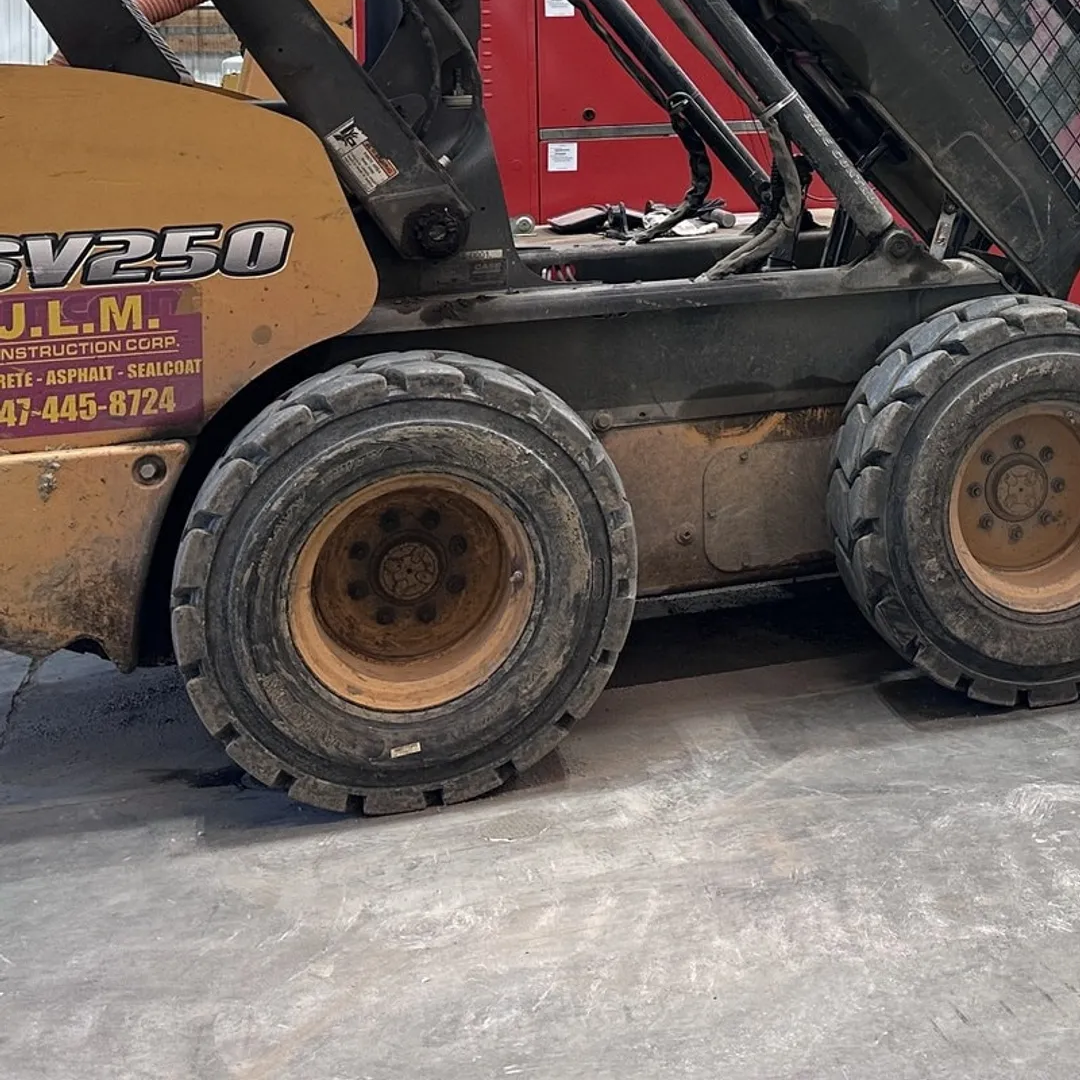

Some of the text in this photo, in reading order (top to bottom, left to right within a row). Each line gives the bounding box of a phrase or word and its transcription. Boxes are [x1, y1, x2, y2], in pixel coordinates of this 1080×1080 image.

[0, 295, 160, 339] J.L.M.
[126, 336, 180, 351] CORP.
[45, 366, 114, 386] ASPHALT
[127, 358, 202, 379] SEALCOAT
